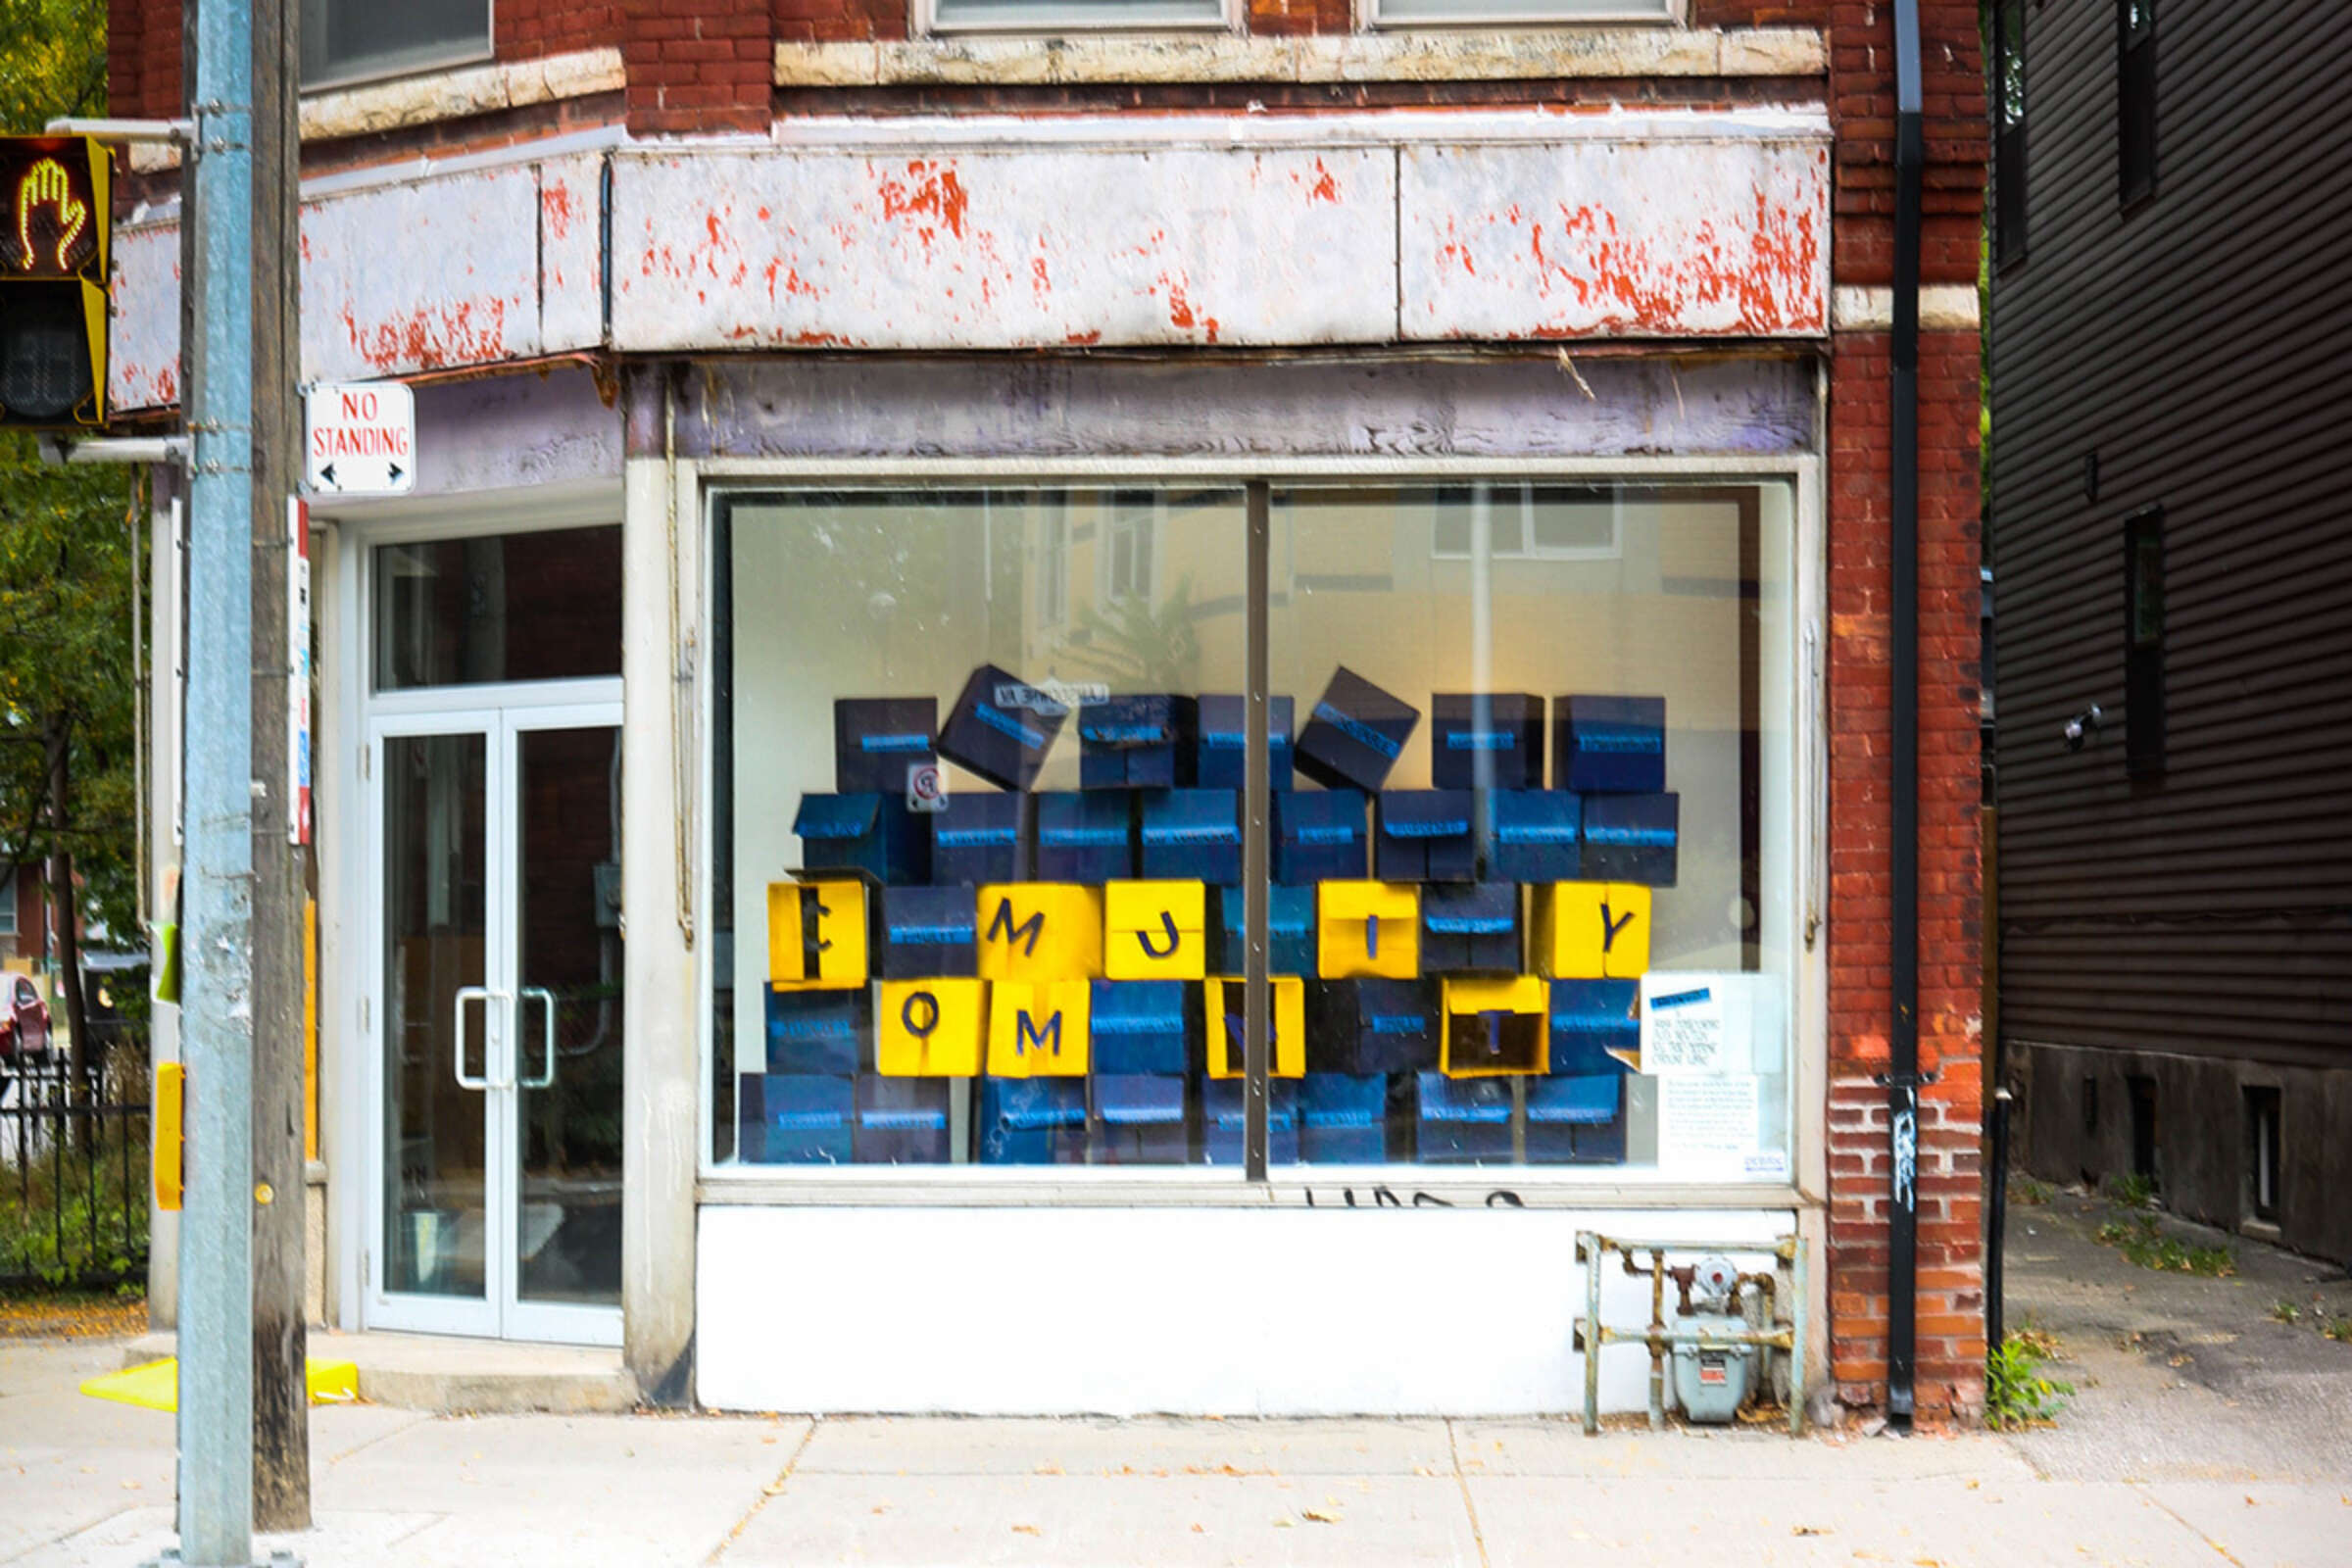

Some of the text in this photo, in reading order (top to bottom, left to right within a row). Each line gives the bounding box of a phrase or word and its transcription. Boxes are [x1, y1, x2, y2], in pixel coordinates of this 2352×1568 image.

[342, 392, 377, 421] NO
[313, 426, 409, 458] STANDING
[986, 897, 1046, 957] M
[1599, 901, 1636, 953] Y
[901, 991, 1515, 1056] O M T
